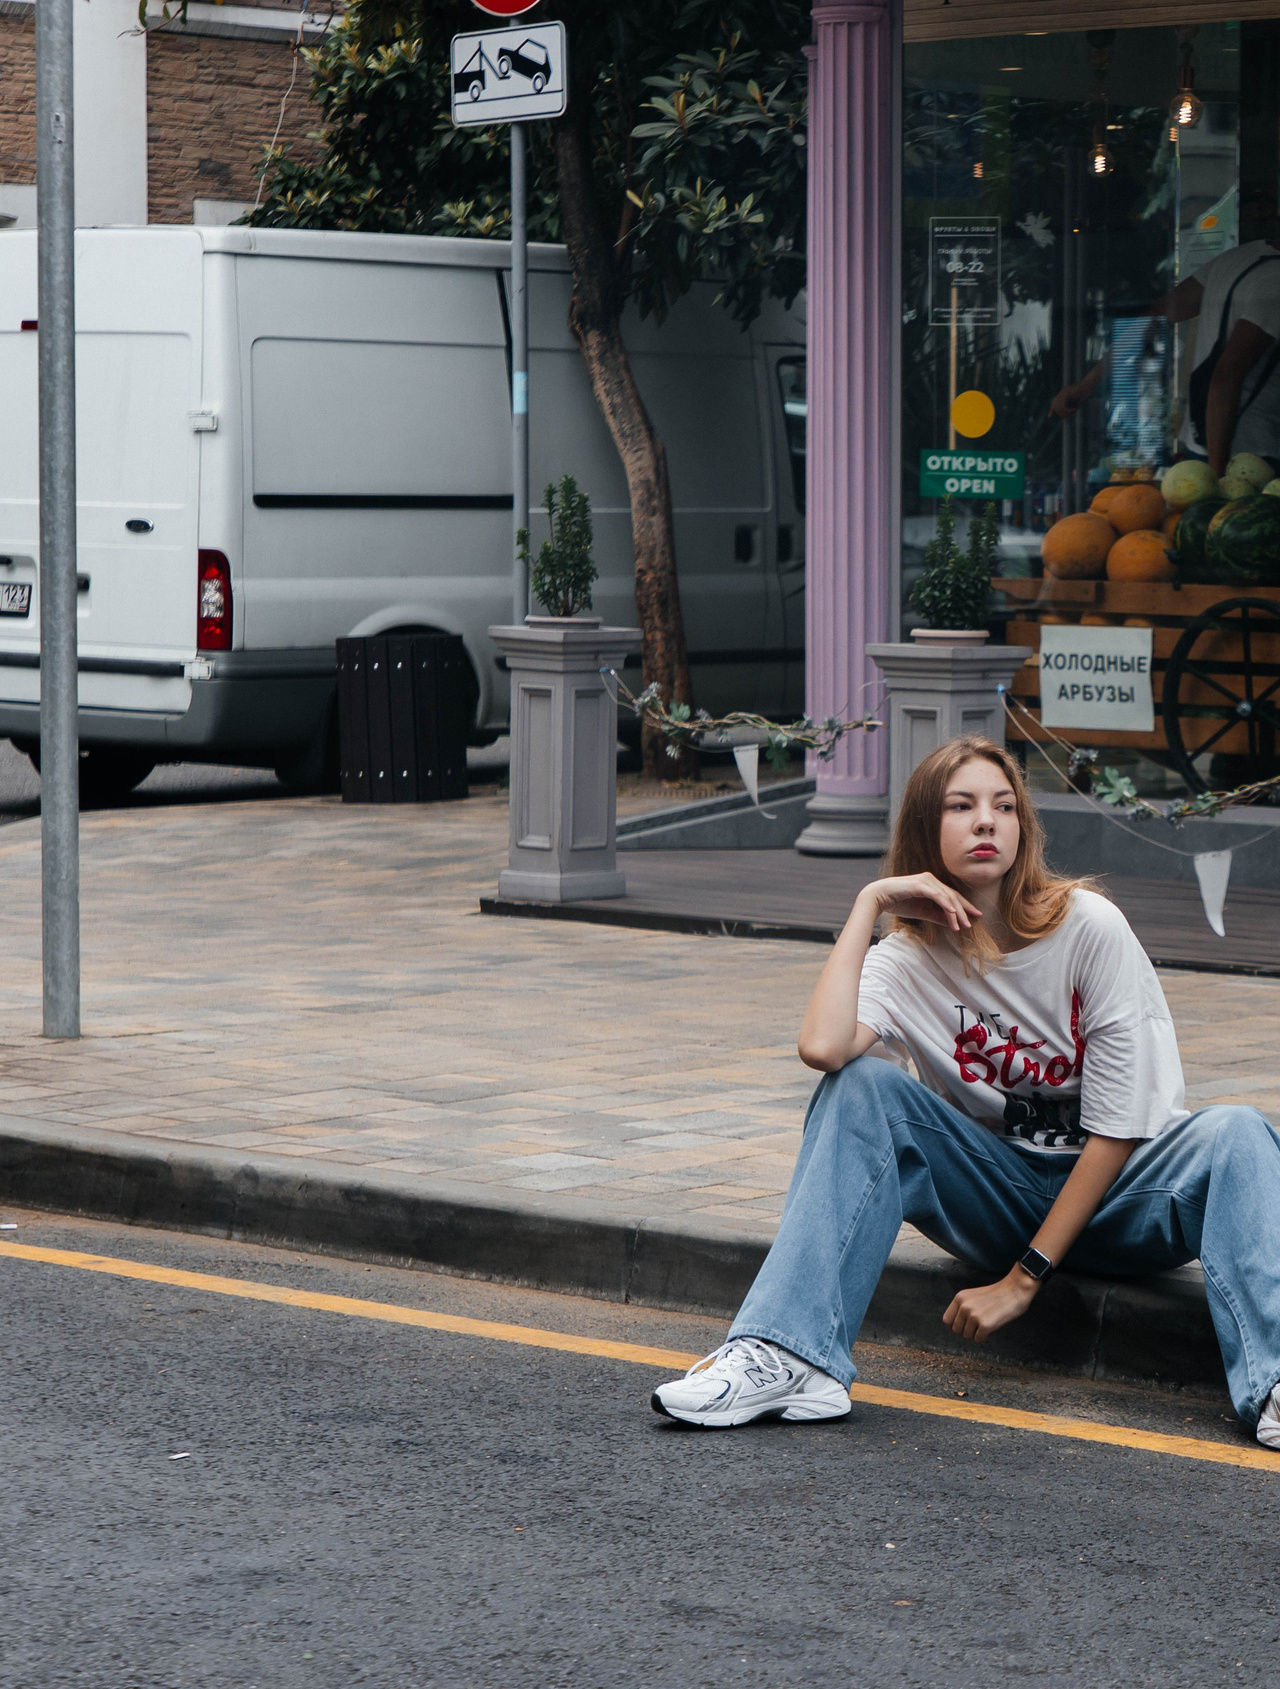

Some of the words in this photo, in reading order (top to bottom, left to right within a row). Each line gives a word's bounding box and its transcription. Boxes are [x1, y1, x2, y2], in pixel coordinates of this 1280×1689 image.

[945, 261, 985, 273] 08-22
[926, 455, 1019, 473] ОТКРЫТО
[945, 477, 996, 494] OPEN
[4, 585, 26, 604] 123
[1042, 653, 1148, 675] ХОЛОДНЫЕ
[1057, 683, 1135, 704] АРБУЗЫ
